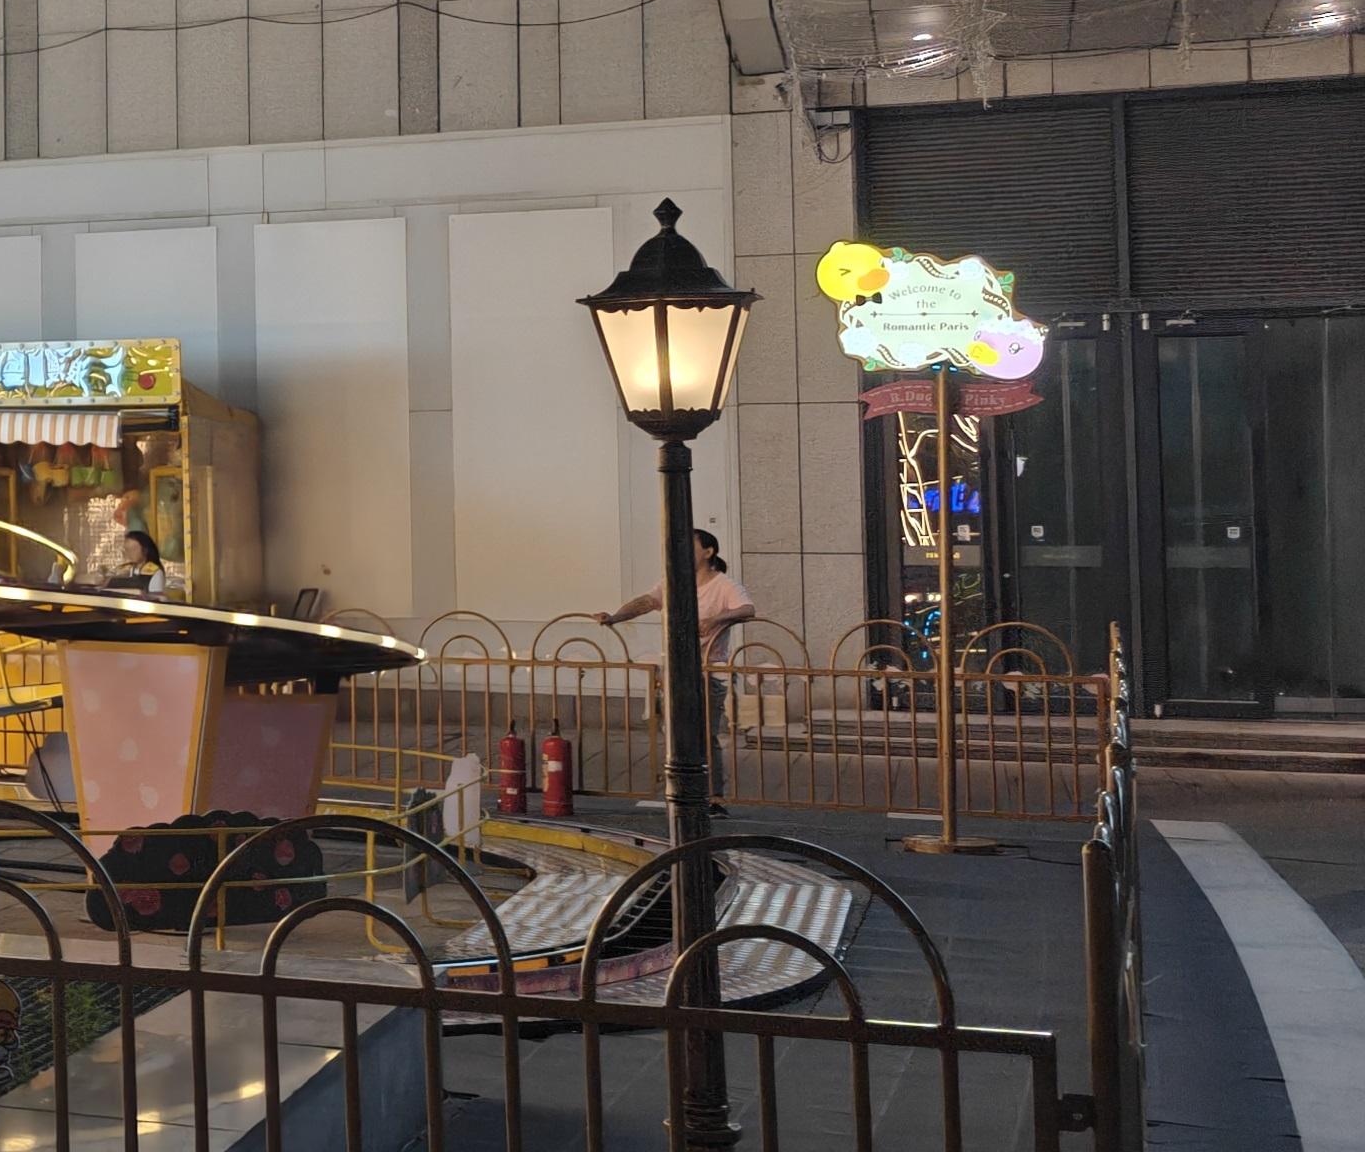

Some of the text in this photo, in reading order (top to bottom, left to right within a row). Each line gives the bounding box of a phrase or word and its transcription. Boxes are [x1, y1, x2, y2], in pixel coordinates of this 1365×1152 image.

[888, 283, 962, 301] Welcome to
[916, 298, 937, 309] the
[883, 322, 969, 332] Romantic Paris
[889, 390, 933, 404] B.Duc
